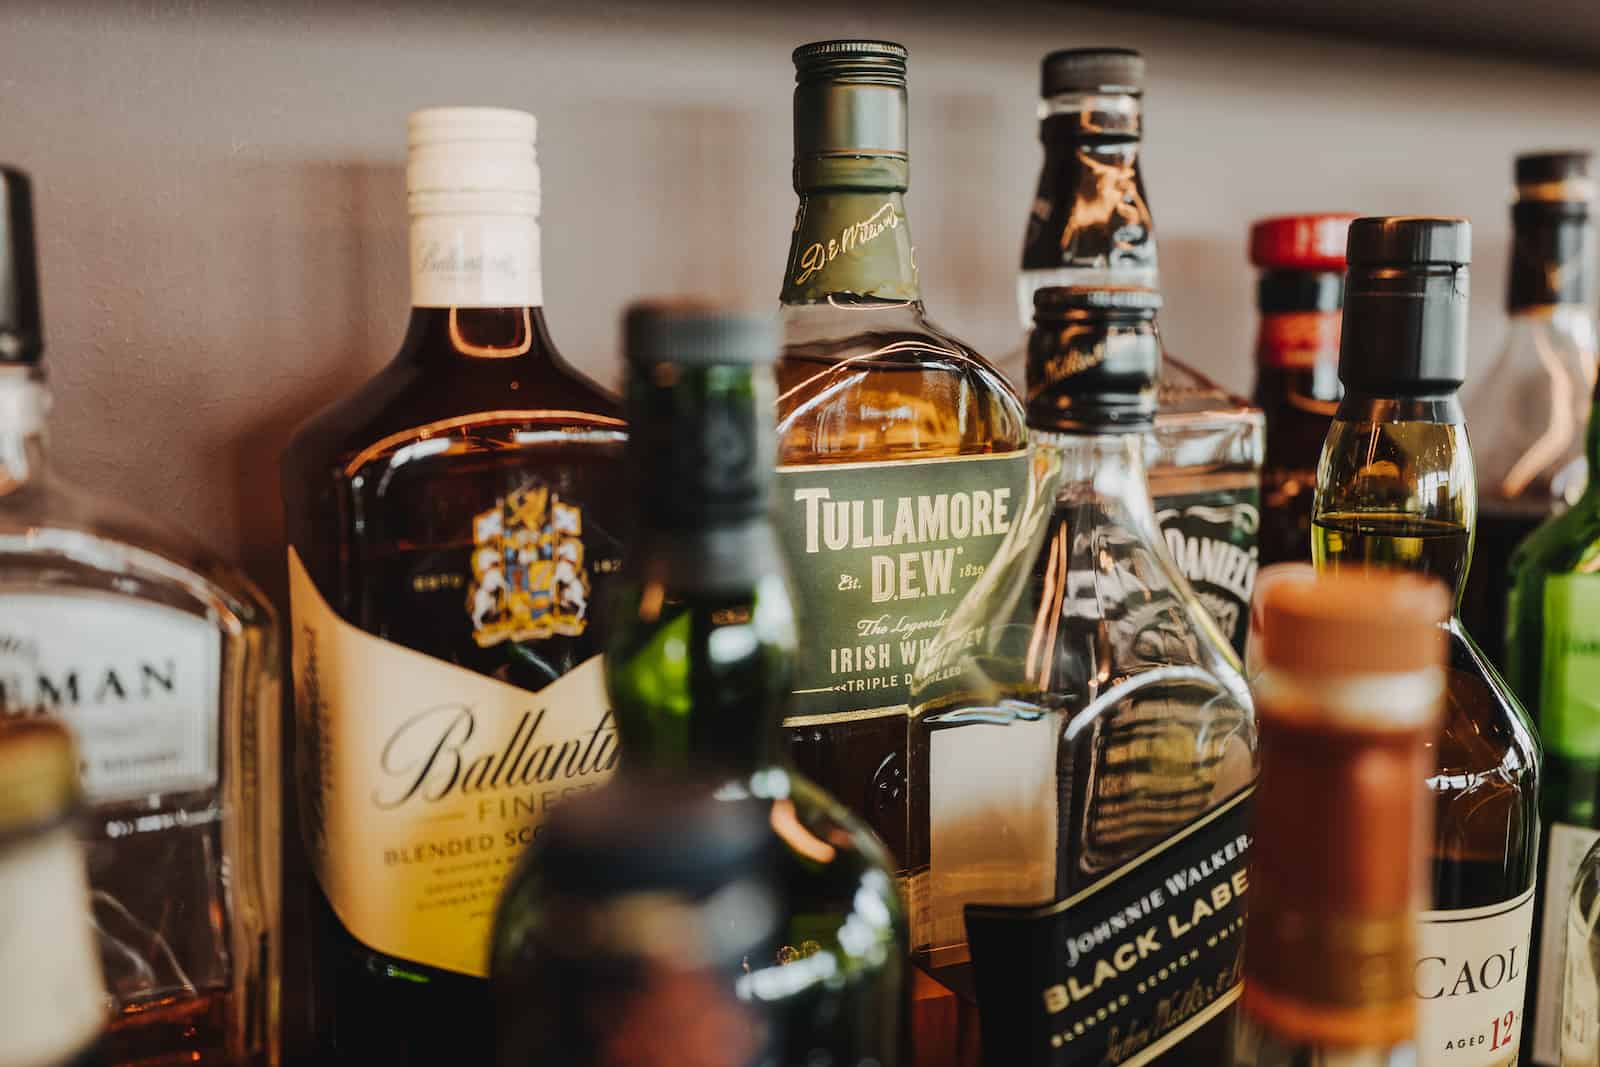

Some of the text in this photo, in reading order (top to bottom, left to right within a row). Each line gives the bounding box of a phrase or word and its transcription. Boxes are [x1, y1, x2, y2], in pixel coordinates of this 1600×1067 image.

[794, 487, 1011, 553] TULLAMORE
[837, 573, 863, 591] Est.
[871, 546, 956, 603] D.E.W.
[857, 608, 951, 640] The Legend
[831, 643, 891, 674] IRISH
[847, 674, 898, 693] TRIPLE
[383, 833, 494, 866] BLENDED
[1043, 926, 1162, 1015] BLACK
[1168, 867, 1249, 940] LABE
[1065, 886, 1166, 968] JOHNNIE
[1051, 994, 1130, 1048] BLENDED
[1136, 948, 1199, 994] SCOTCH
[1207, 912, 1249, 947] WHIS
[1412, 944, 1520, 1001] CAOL
[1444, 1010, 1515, 1053] AGED 12
